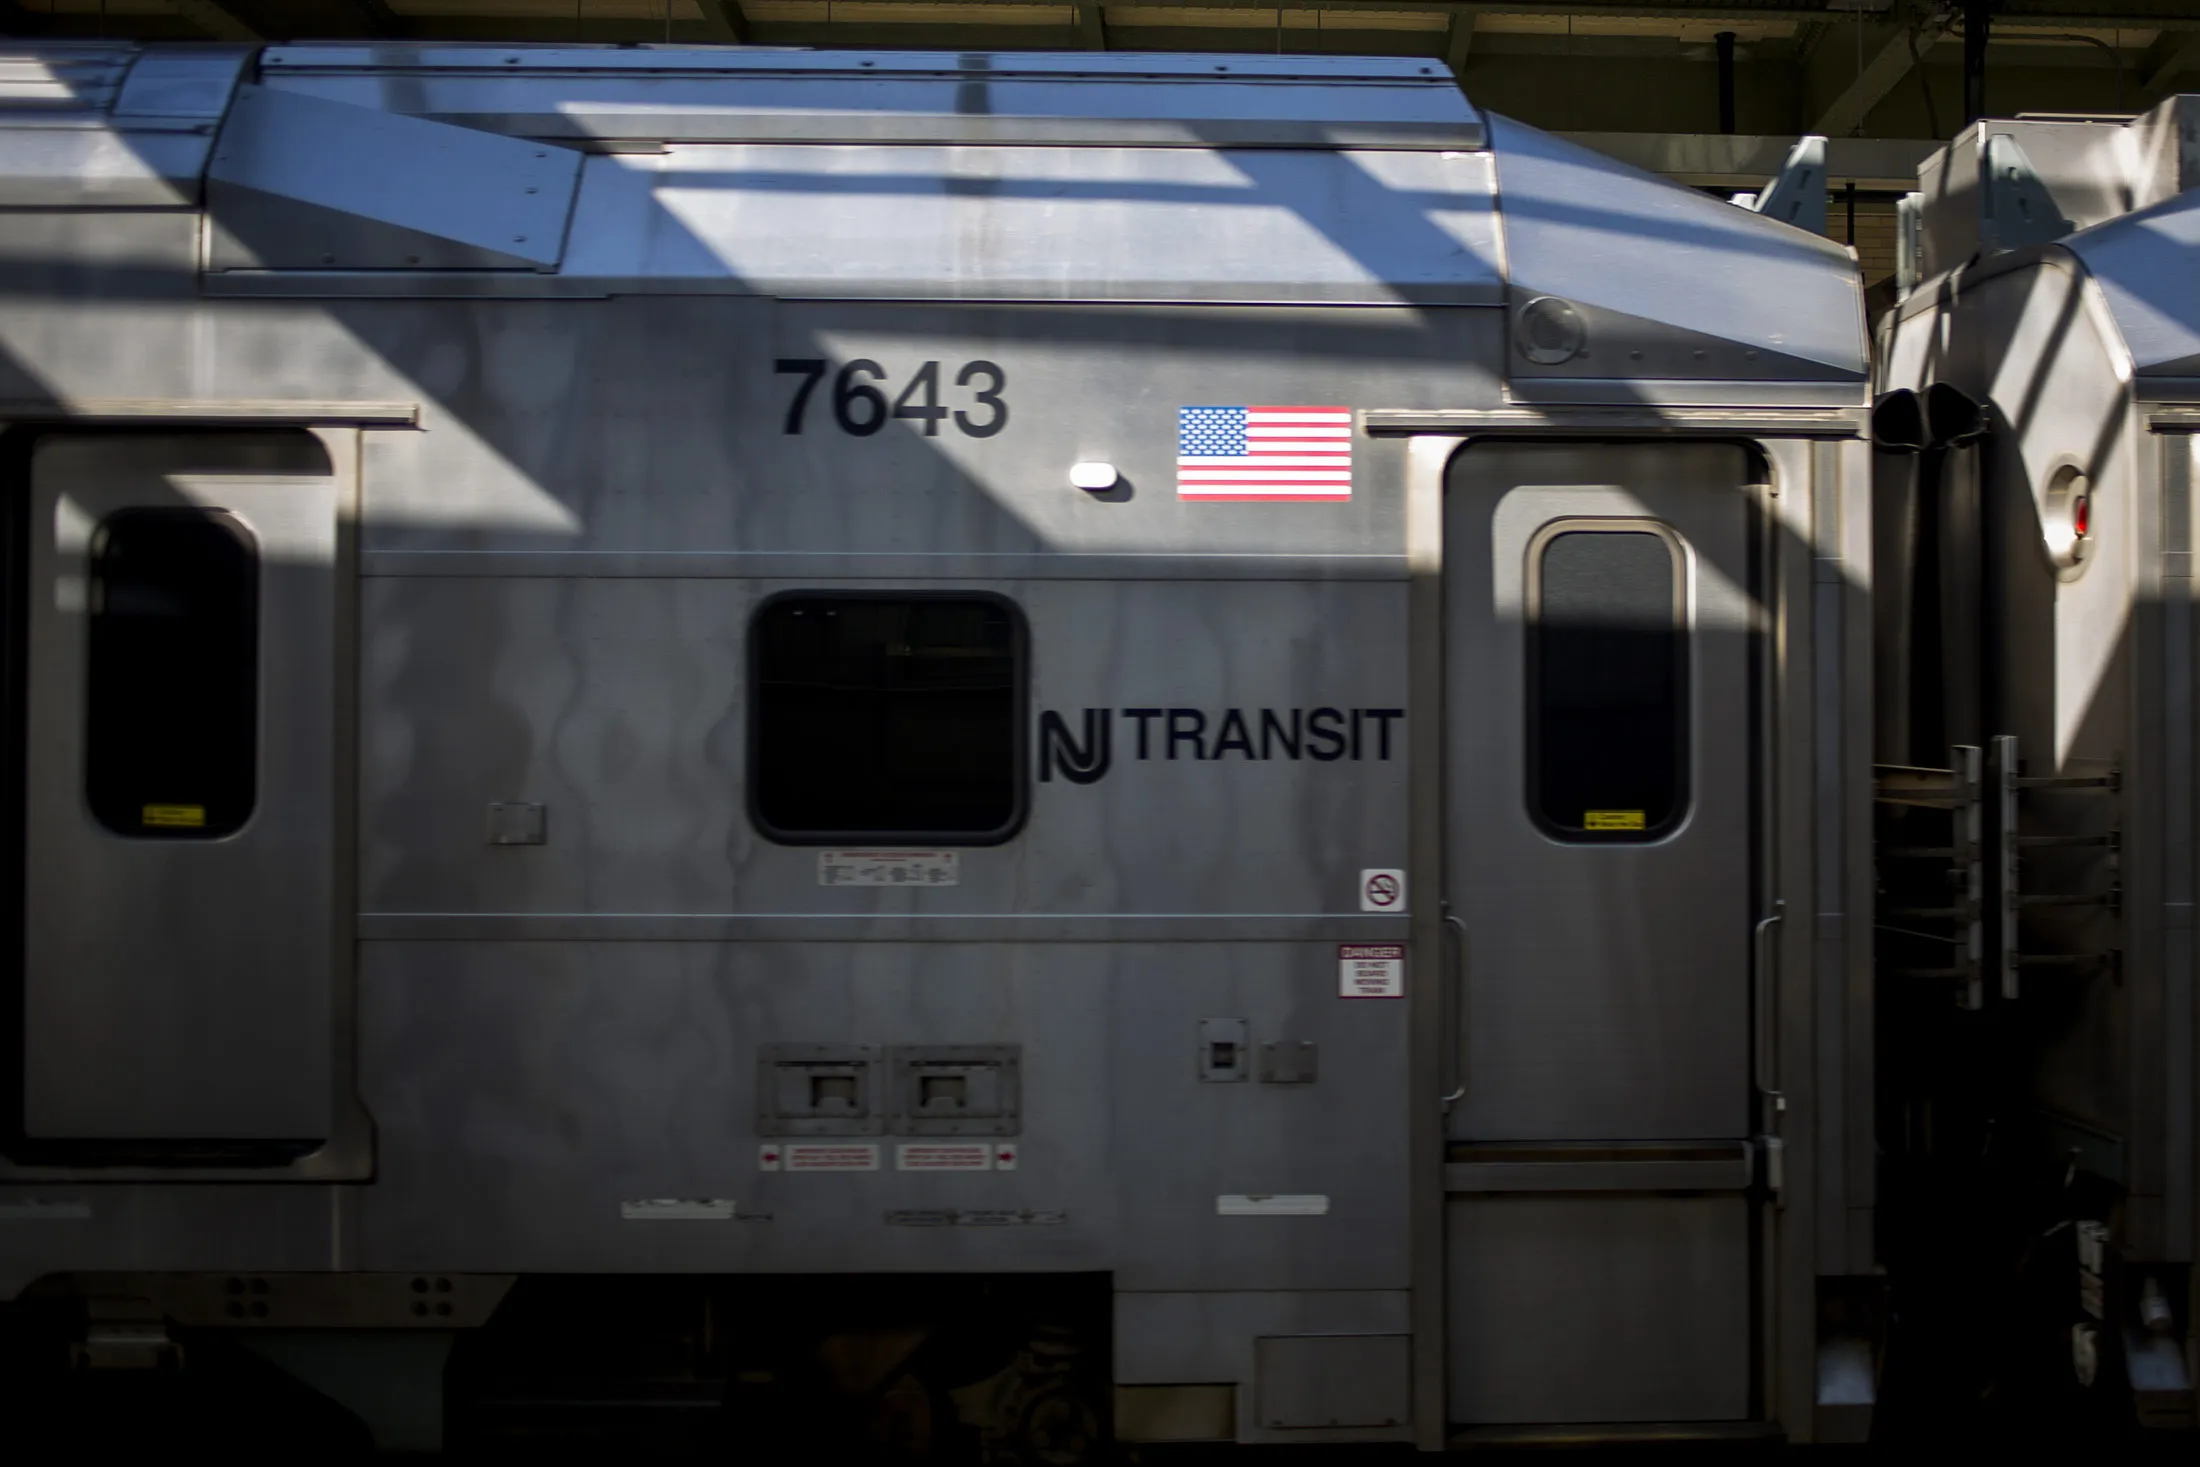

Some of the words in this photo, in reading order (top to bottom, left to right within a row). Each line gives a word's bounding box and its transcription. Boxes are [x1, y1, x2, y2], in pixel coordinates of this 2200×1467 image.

[774, 358, 1008, 438] 7643
[1037, 708, 1112, 784] NJ
[1121, 707, 1405, 761] TRANSIT
[1341, 947, 1401, 958] DANGER
